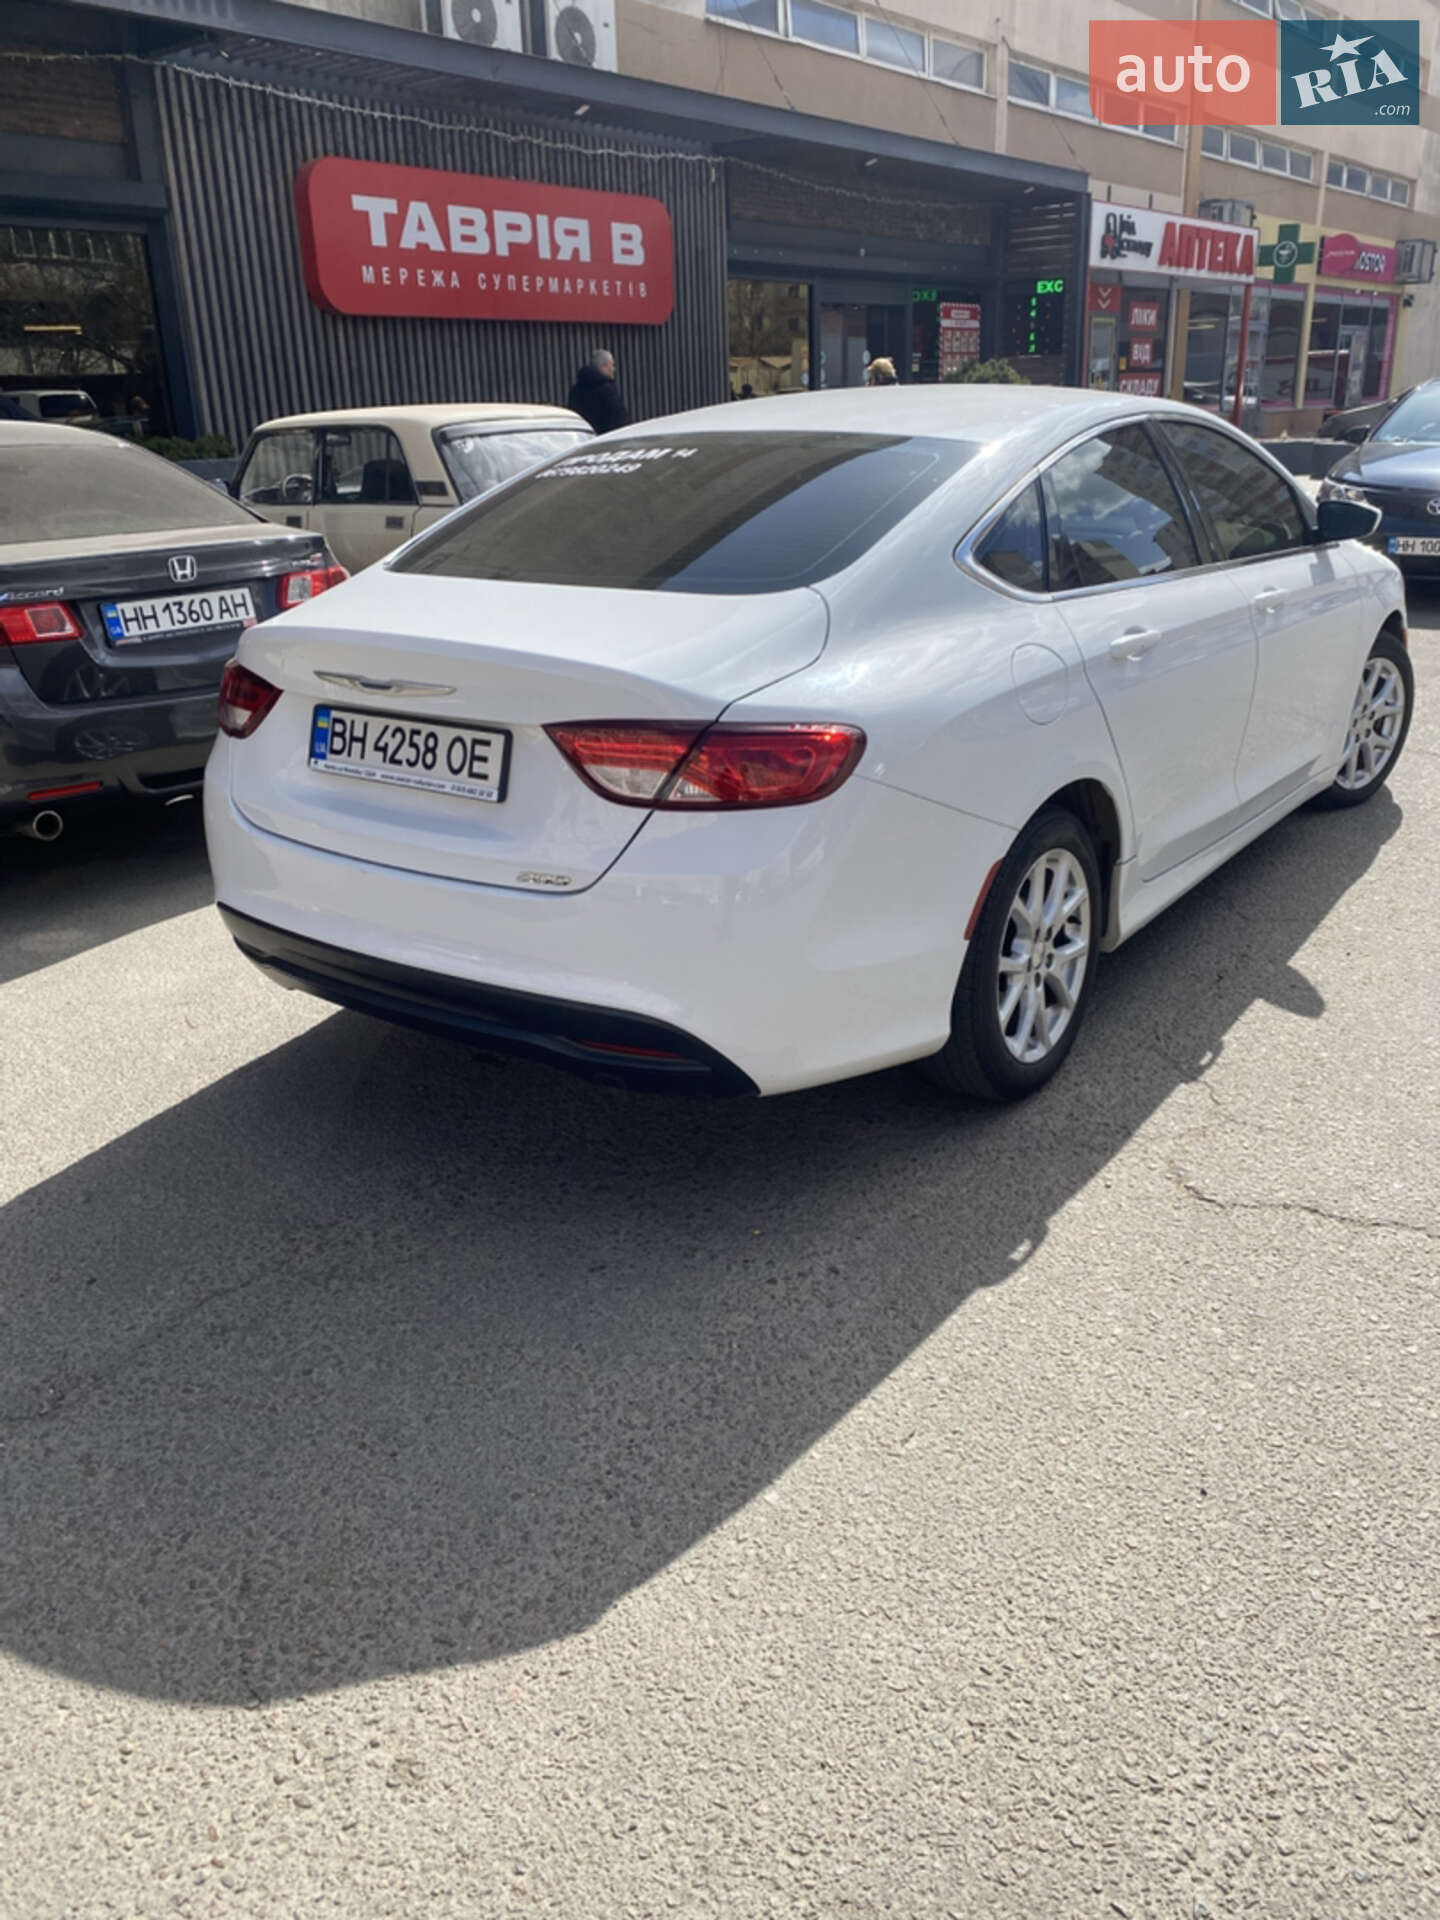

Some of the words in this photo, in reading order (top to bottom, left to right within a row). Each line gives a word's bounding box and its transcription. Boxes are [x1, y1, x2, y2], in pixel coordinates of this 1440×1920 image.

[351, 194, 591, 263] ТАВРІЯ
[610, 222, 645, 266] В
[1157, 221, 1254, 275] АПТЕКА
[361, 265, 460, 289] МЕРЕЖА
[478, 272, 648, 298] СУПЕРМАРКЕТІВ
[1130, 307, 1157, 326] ЛІКИ
[1131, 343, 1151, 364] ВІД
[1396, 540, 1416, 553] HH
[121, 604, 160, 632] HH
[162, 598, 214, 627] 1360
[218, 593, 249, 620] AH
[329, 717, 368, 760] BH
[373, 724, 439, 771] 4258
[447, 735, 491, 781] OE
